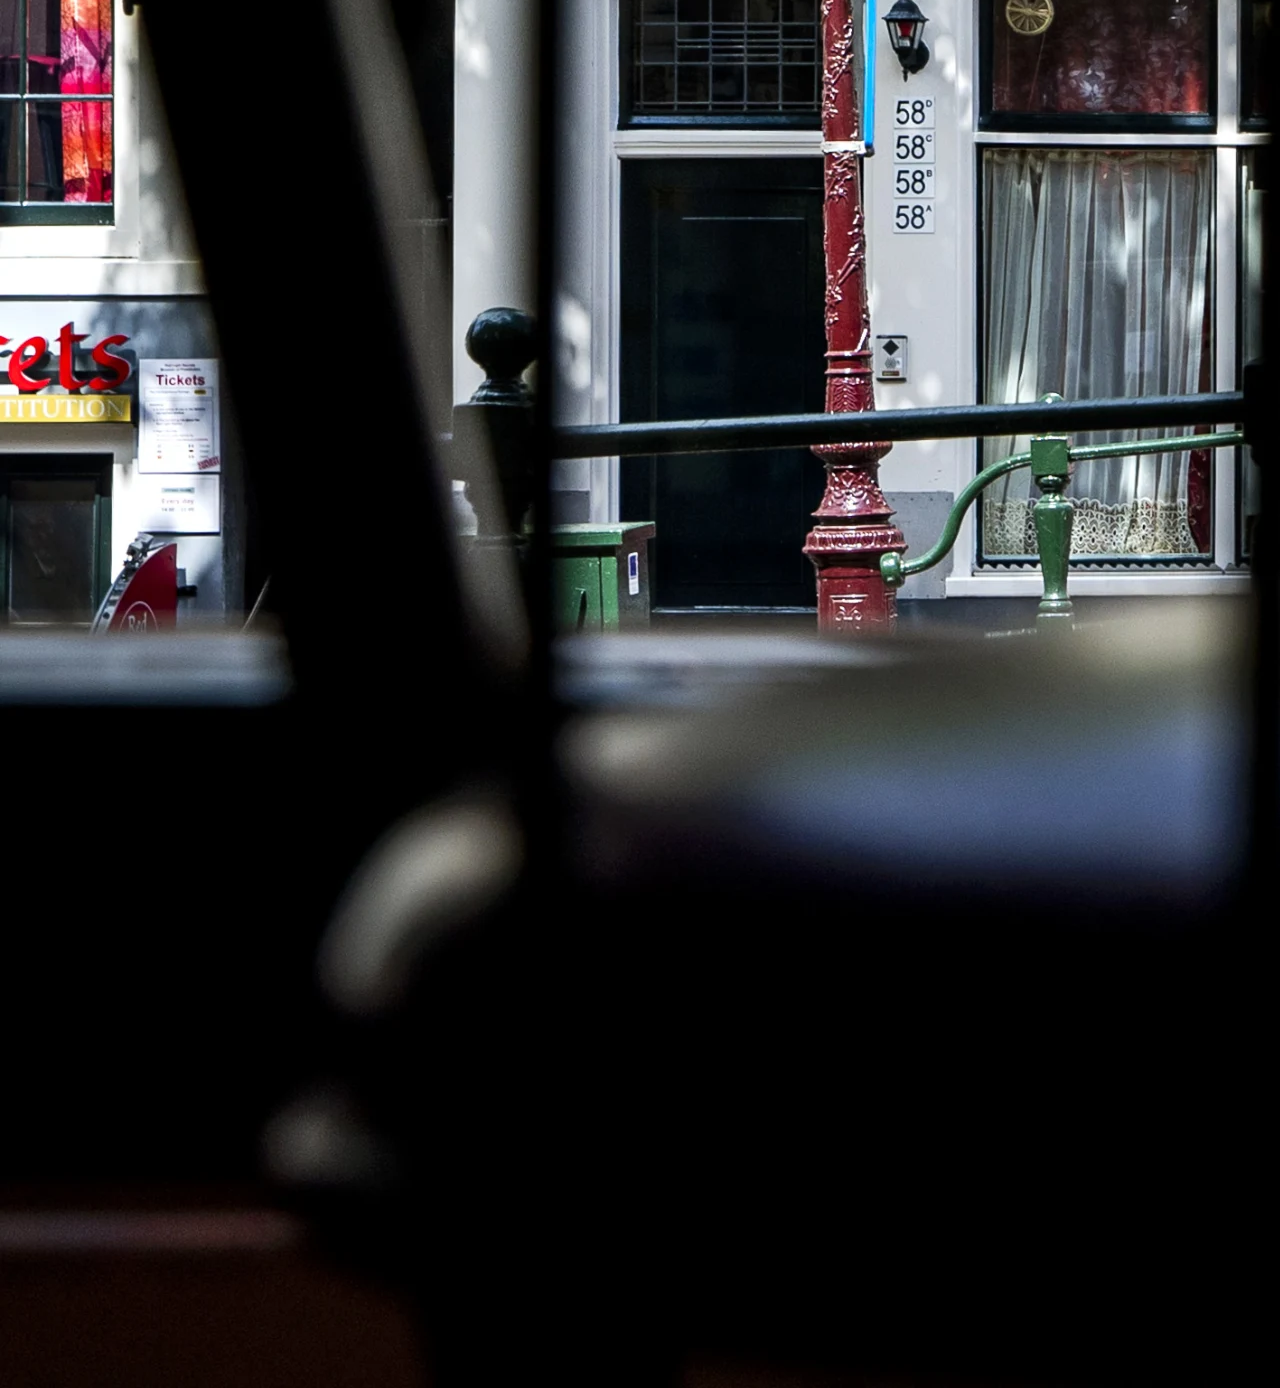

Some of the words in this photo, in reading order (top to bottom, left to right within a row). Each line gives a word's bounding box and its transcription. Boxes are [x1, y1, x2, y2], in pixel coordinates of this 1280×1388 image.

[0, 321, 131, 391] ets
[155, 374, 206, 386] Tickets
[0, 398, 125, 419] TITUTION
[128, 612, 148, 633] Red
